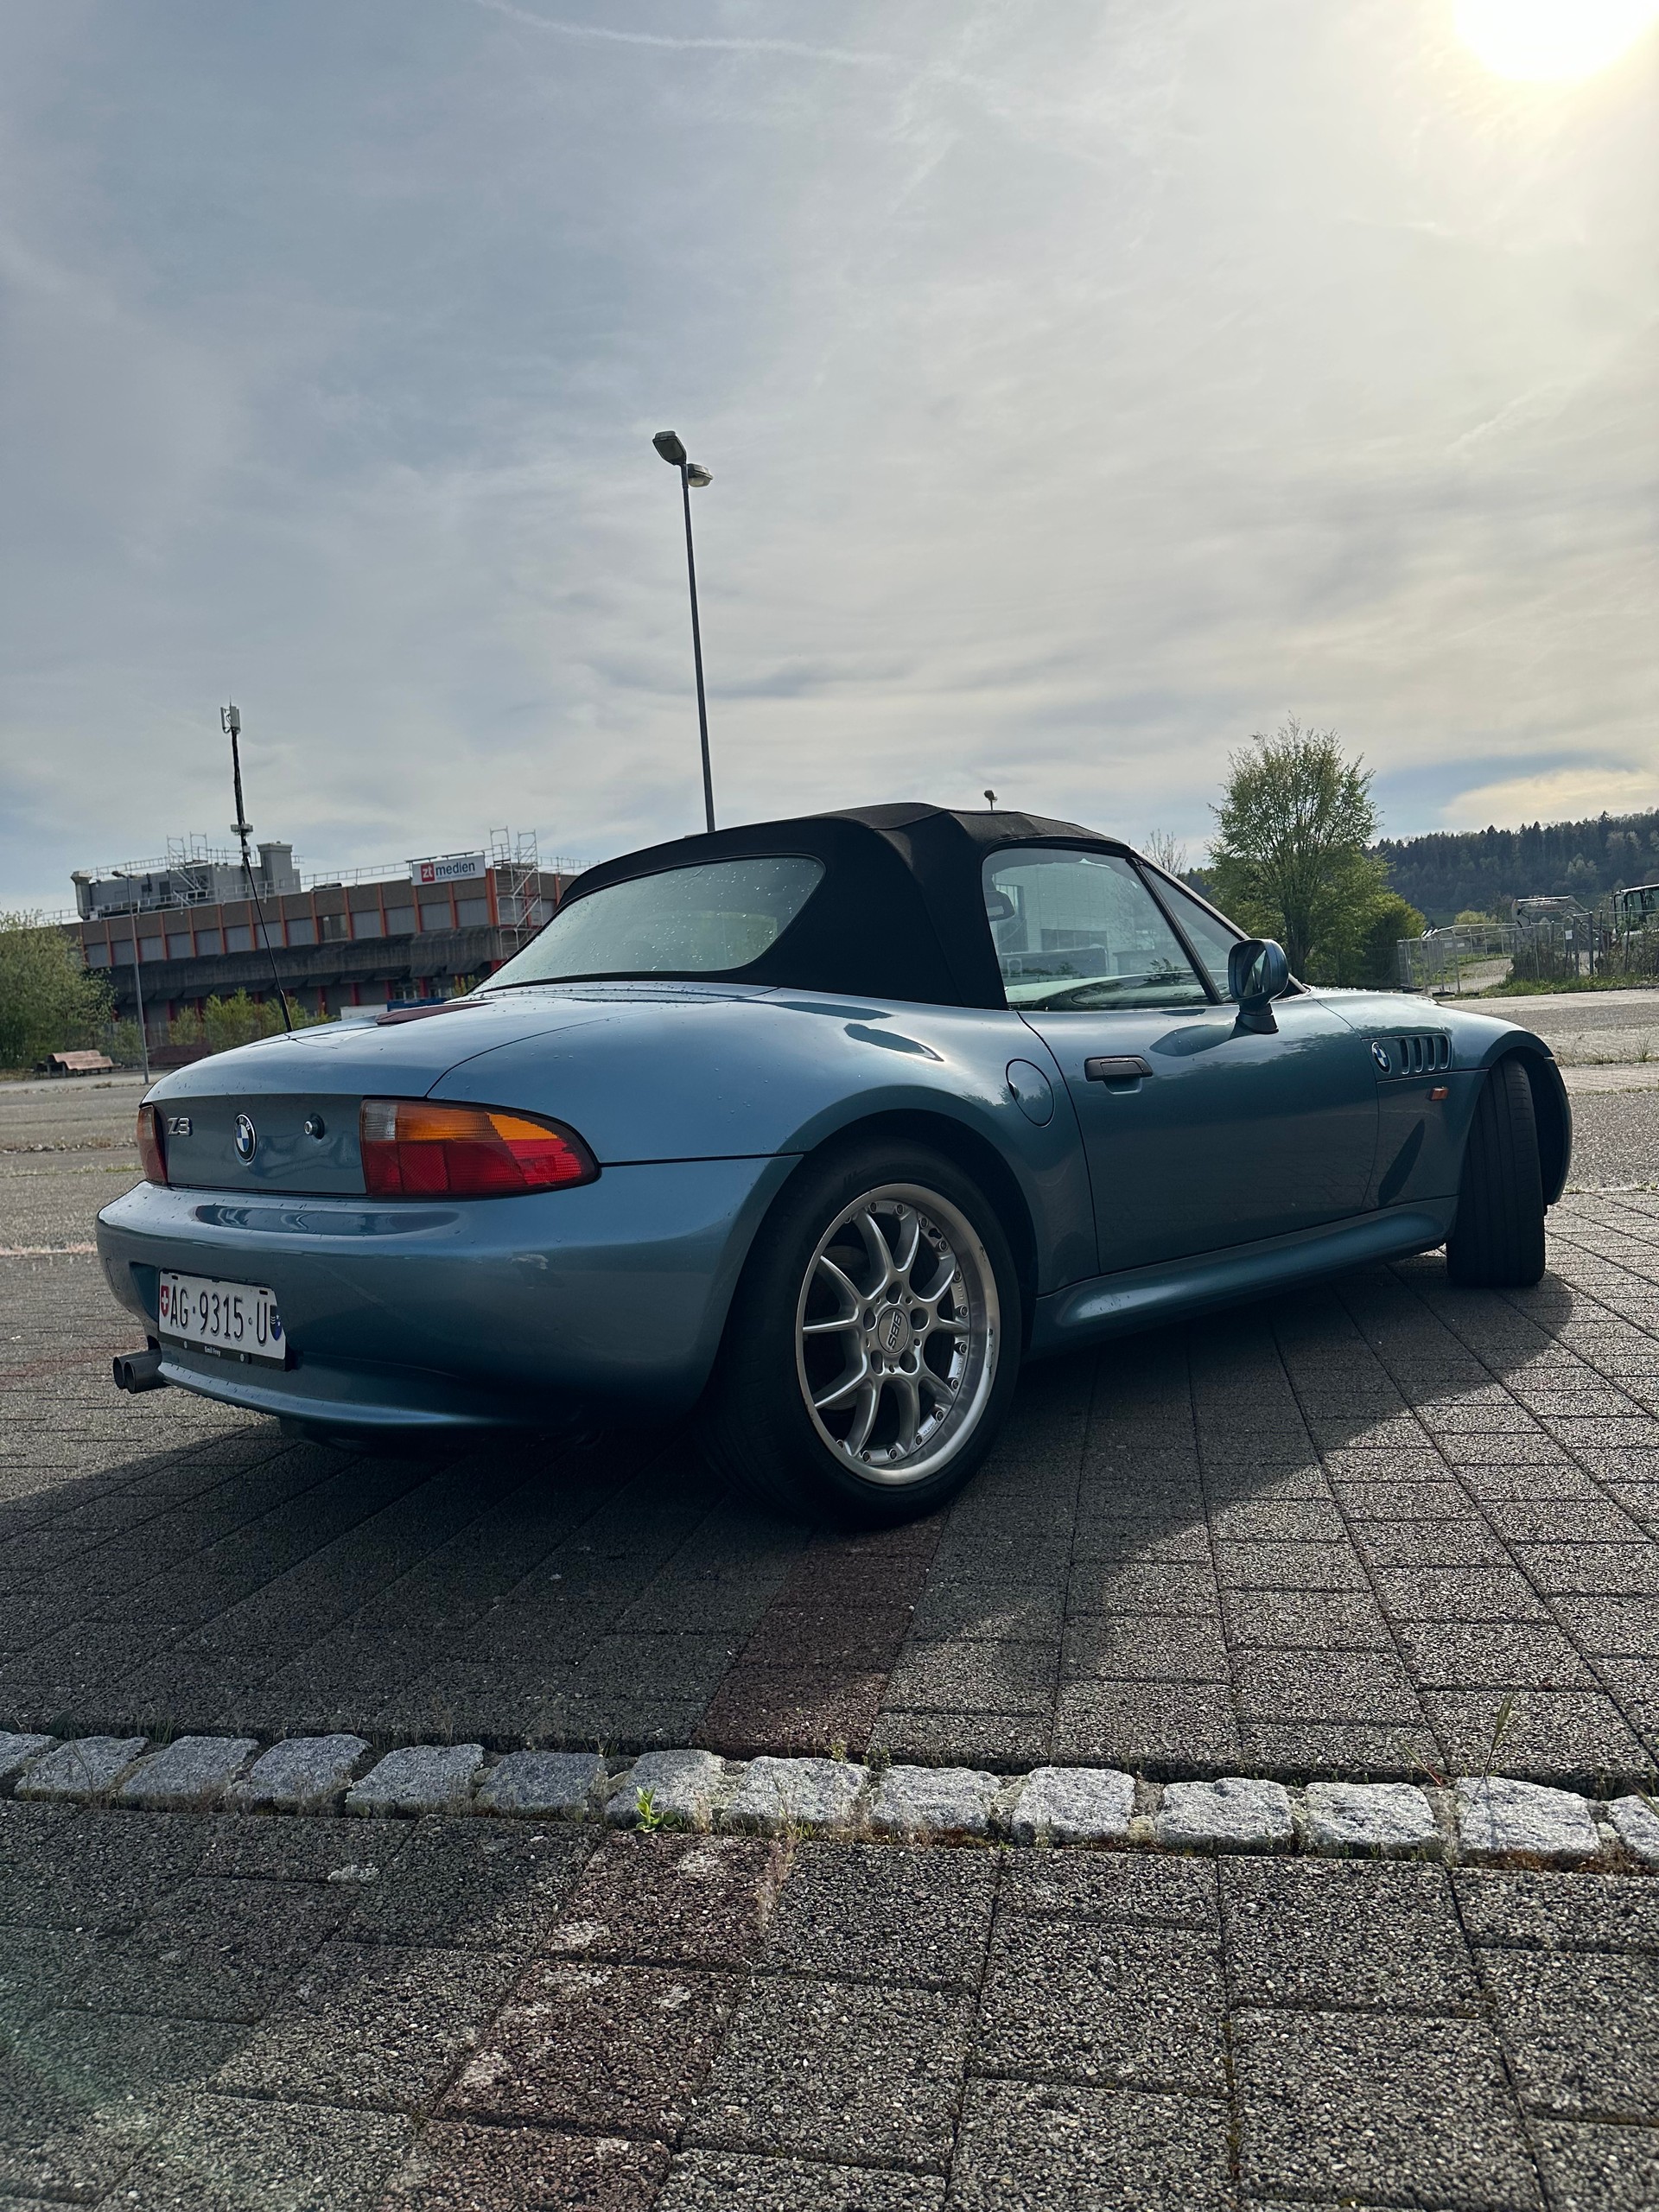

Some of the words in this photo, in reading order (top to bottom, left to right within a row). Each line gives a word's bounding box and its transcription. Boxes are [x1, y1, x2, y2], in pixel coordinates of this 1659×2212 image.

[422, 865, 434, 878] zt
[435, 861, 475, 876] medien
[167, 1117, 190, 1136] Z3
[886, 1311, 902, 1351] BBS
